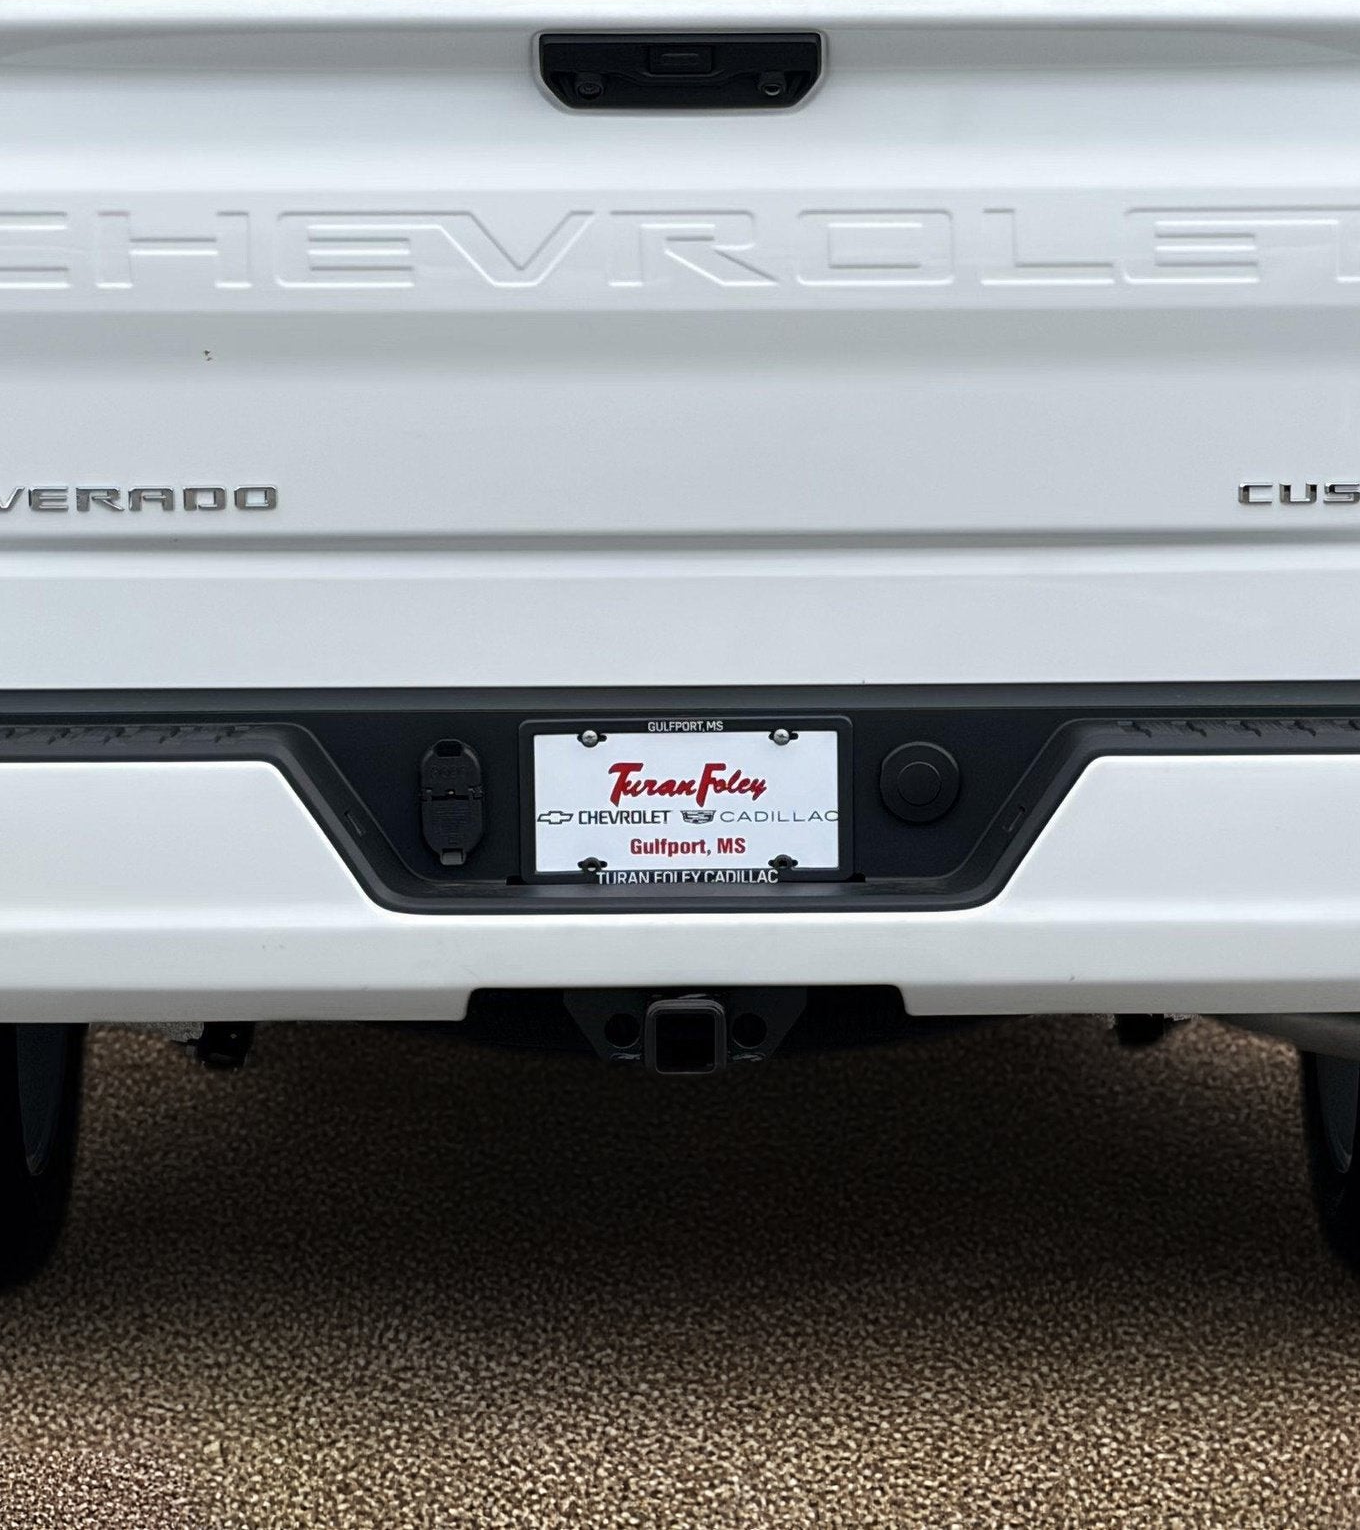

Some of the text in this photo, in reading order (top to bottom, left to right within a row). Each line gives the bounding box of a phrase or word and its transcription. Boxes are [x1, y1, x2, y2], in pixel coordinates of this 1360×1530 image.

[706, 720, 724, 732] MS
[578, 810, 840, 825] CHEVROLET CADILLAC
[630, 837, 746, 857] Gulfport, MS
[596, 872, 650, 884] TURAN
[704, 870, 779, 884] CADILLAC
